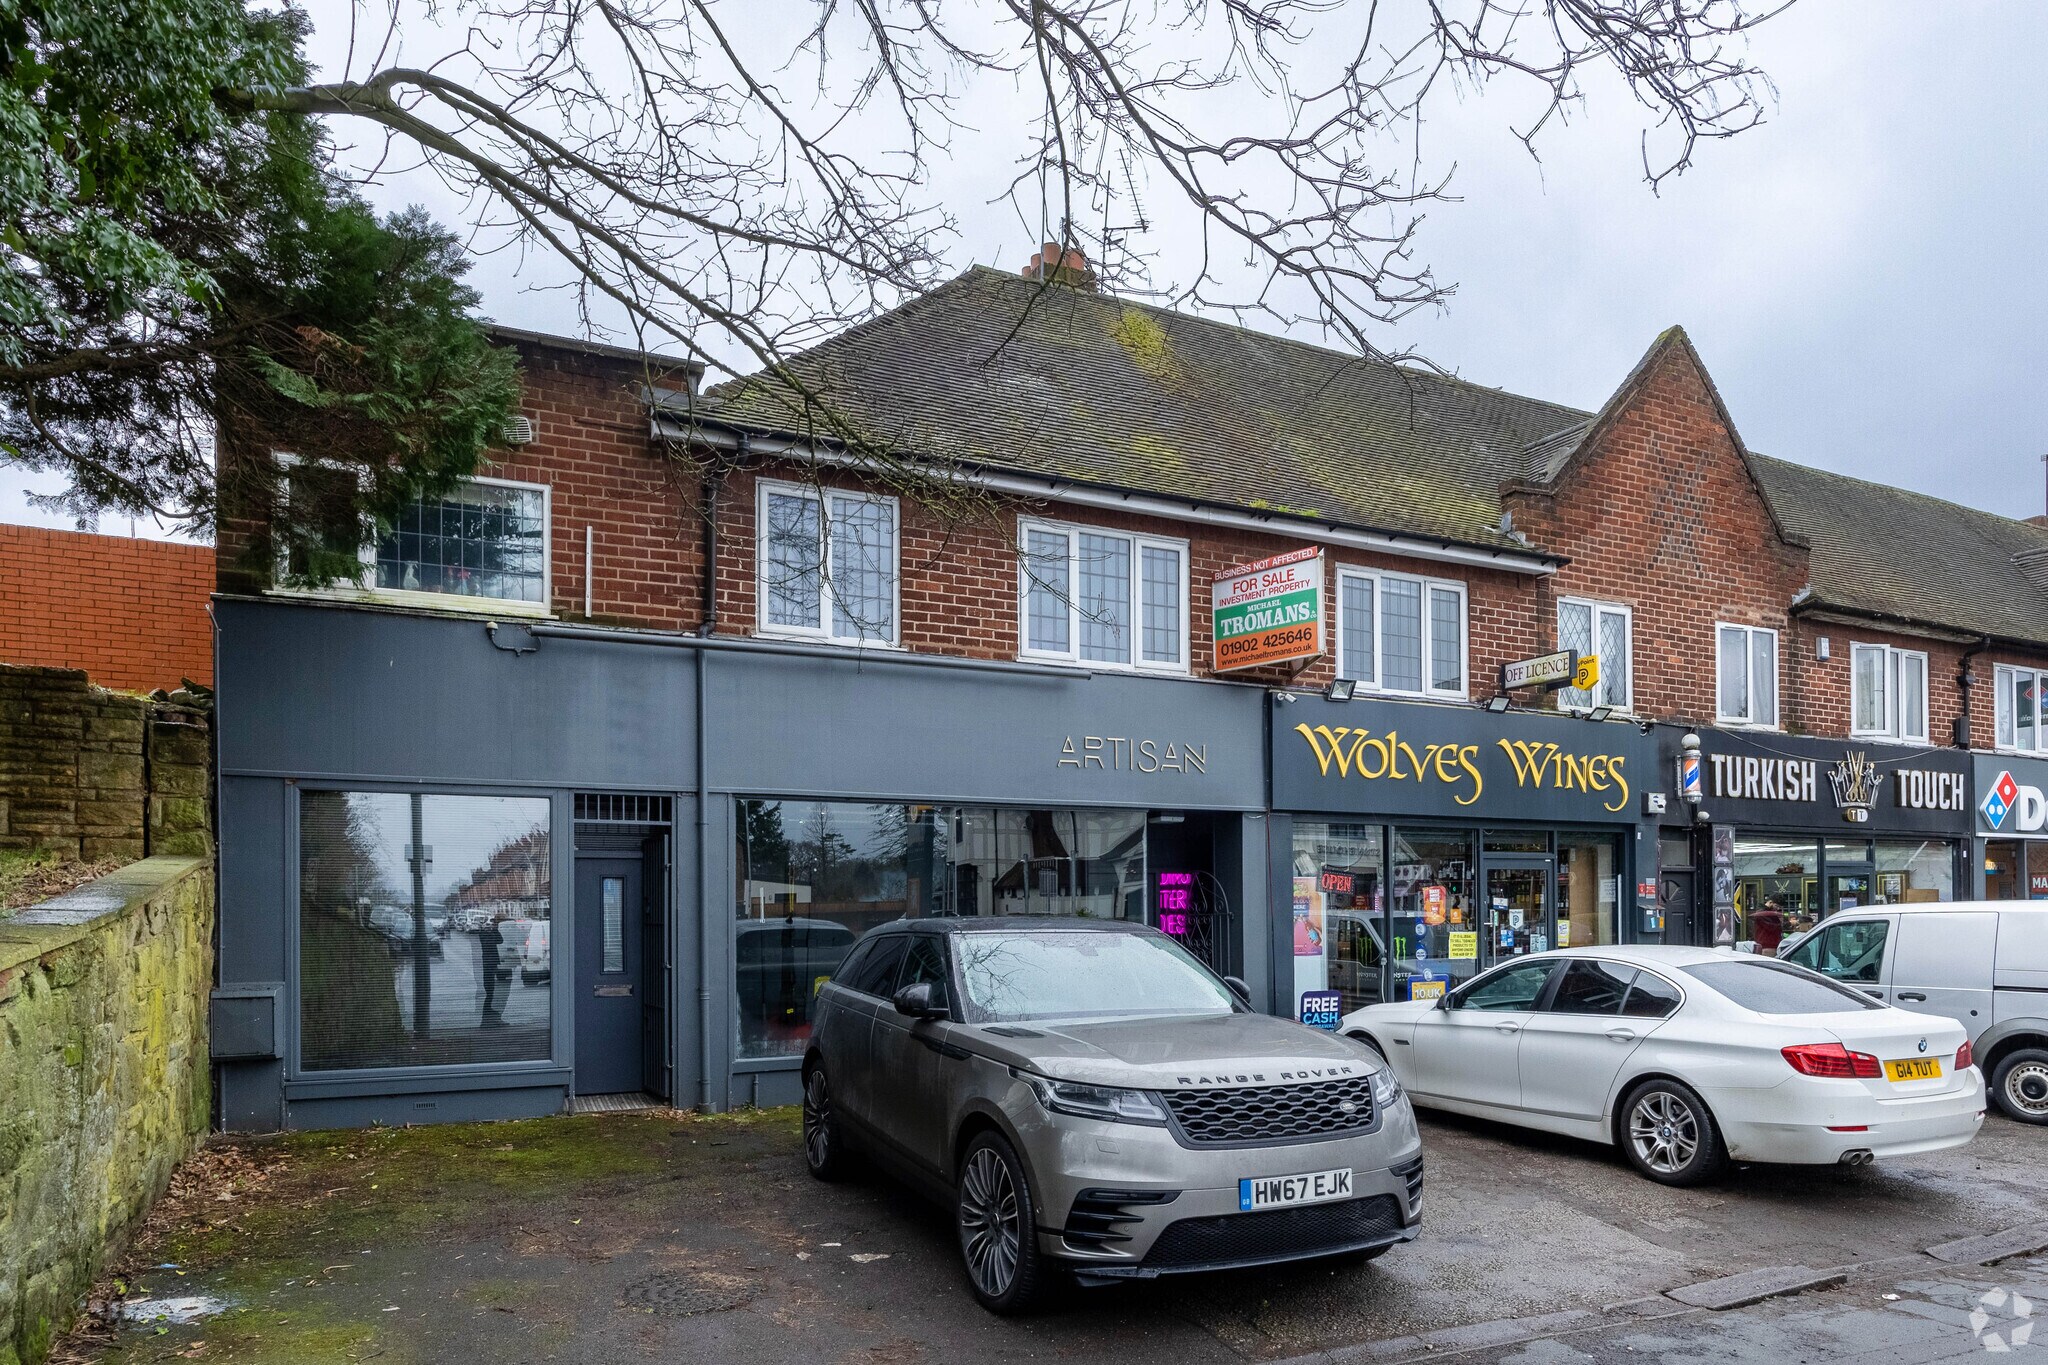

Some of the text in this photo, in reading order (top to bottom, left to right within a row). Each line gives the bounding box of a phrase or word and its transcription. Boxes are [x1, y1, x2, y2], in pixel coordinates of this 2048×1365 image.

[1214, 549, 1313, 581] BUSINESS NOT AFFECTED
[1219, 579, 1311, 607] INVESTMENT PROPERTY
[1233, 568, 1295, 594] FOR SALE
[1247, 599, 1282, 612] MICHAEL
[1220, 601, 1310, 636] TROMANS
[1221, 628, 1312, 656] 01902 425646
[1221, 643, 1312, 666] www.michaeltromans.co.uk
[1505, 657, 1569, 682] OFF LICENCE
[1577, 658, 1595, 667] yPoint
[1057, 735, 1206, 774] ARTISAN
[1294, 723, 1630, 812] WOLVES WINES
[1710, 753, 1965, 811] TURKISH TOUCH
[1322, 873, 1352, 892] OPEN
[1303, 996, 1339, 1013] FREE
[1303, 1012, 1338, 1026] CASH
[1177, 1066, 1353, 1085] RANGE ROVER
[1896, 1061, 1933, 1078] G14 TUT
[1255, 1171, 1351, 1205] HW67 EJK
